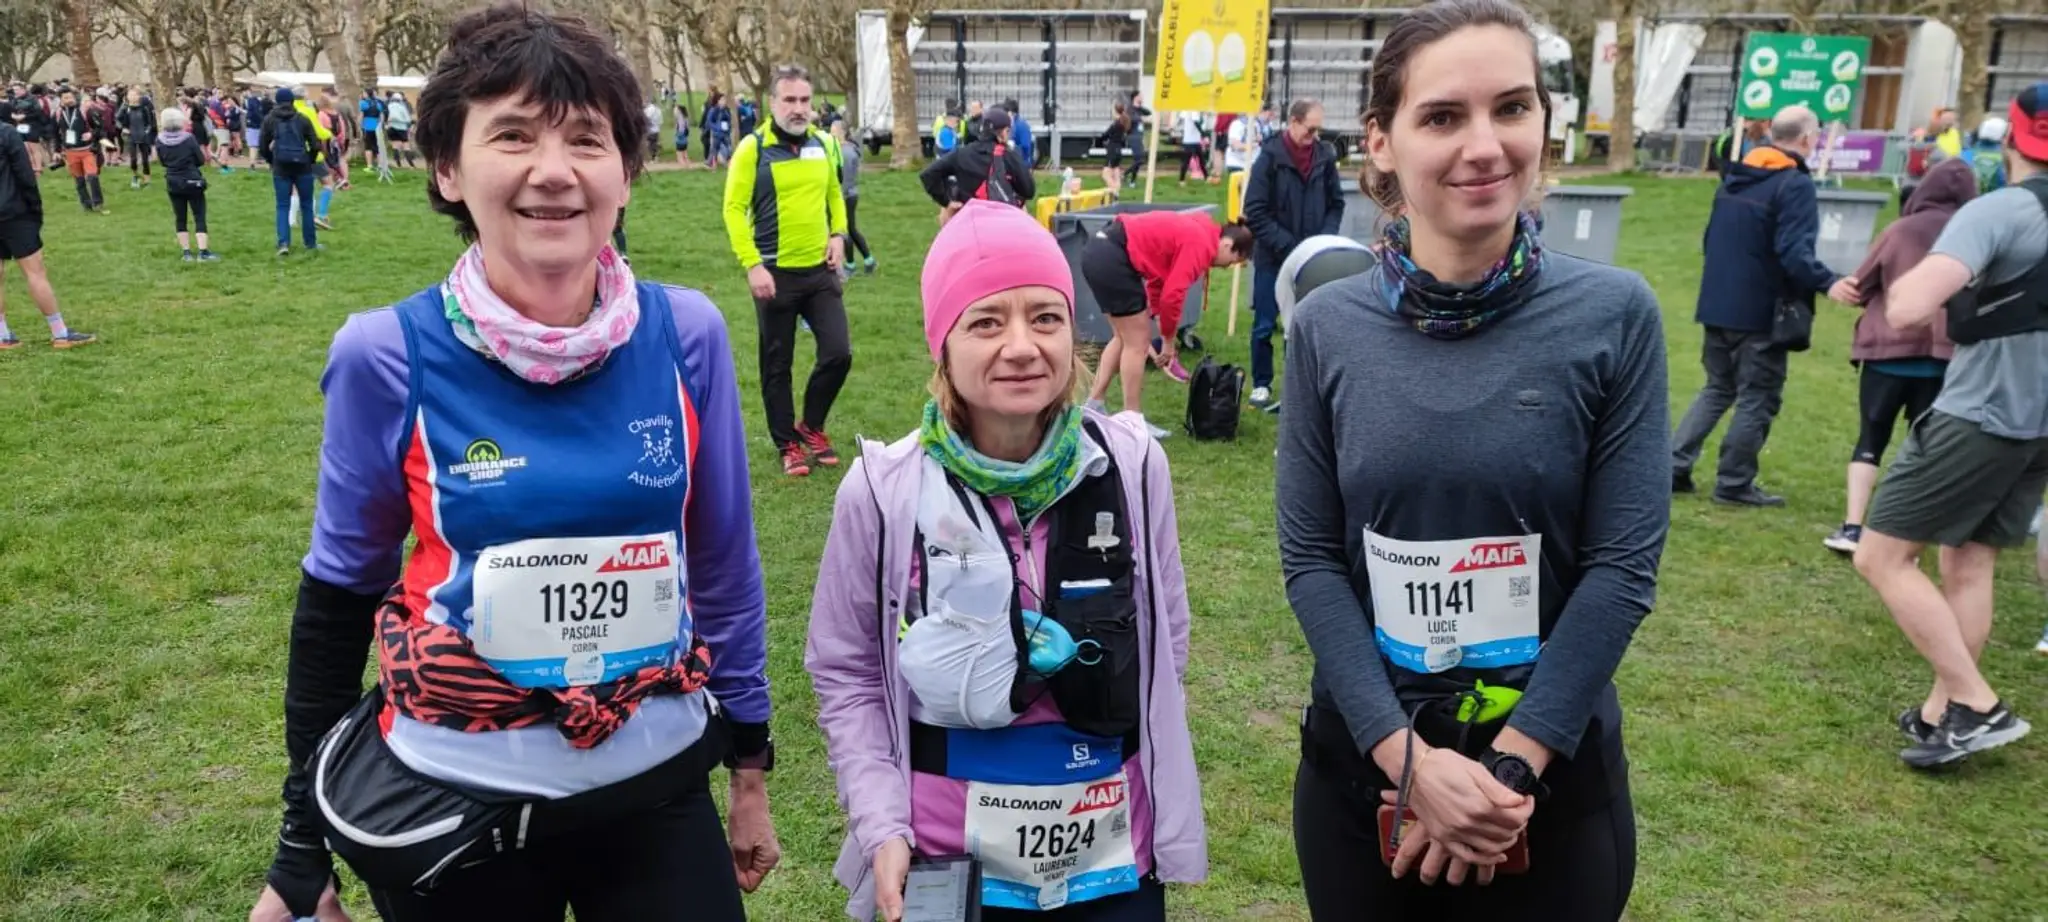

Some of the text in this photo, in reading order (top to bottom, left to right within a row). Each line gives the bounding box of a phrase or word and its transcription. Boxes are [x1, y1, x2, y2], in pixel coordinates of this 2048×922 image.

[1161, 0, 1179, 99] RECYCLABLE
[628, 414, 674, 434] Chaville
[449, 456, 527, 475] ENDURANCE
[469, 469, 504, 481] SHOP
[488, 543, 667, 570] SALOMON MAIF
[1370, 544, 1524, 568] SALOMON MAIF
[540, 580, 629, 624] 11329
[1404, 578, 1474, 617] 11141
[562, 624, 609, 641] PASCALE
[1427, 619, 1458, 634] LUCIE
[978, 784, 1125, 811] SALOMON MAIF
[1016, 818, 1096, 858] 12624
[1034, 855, 1079, 875] LAURENCE
